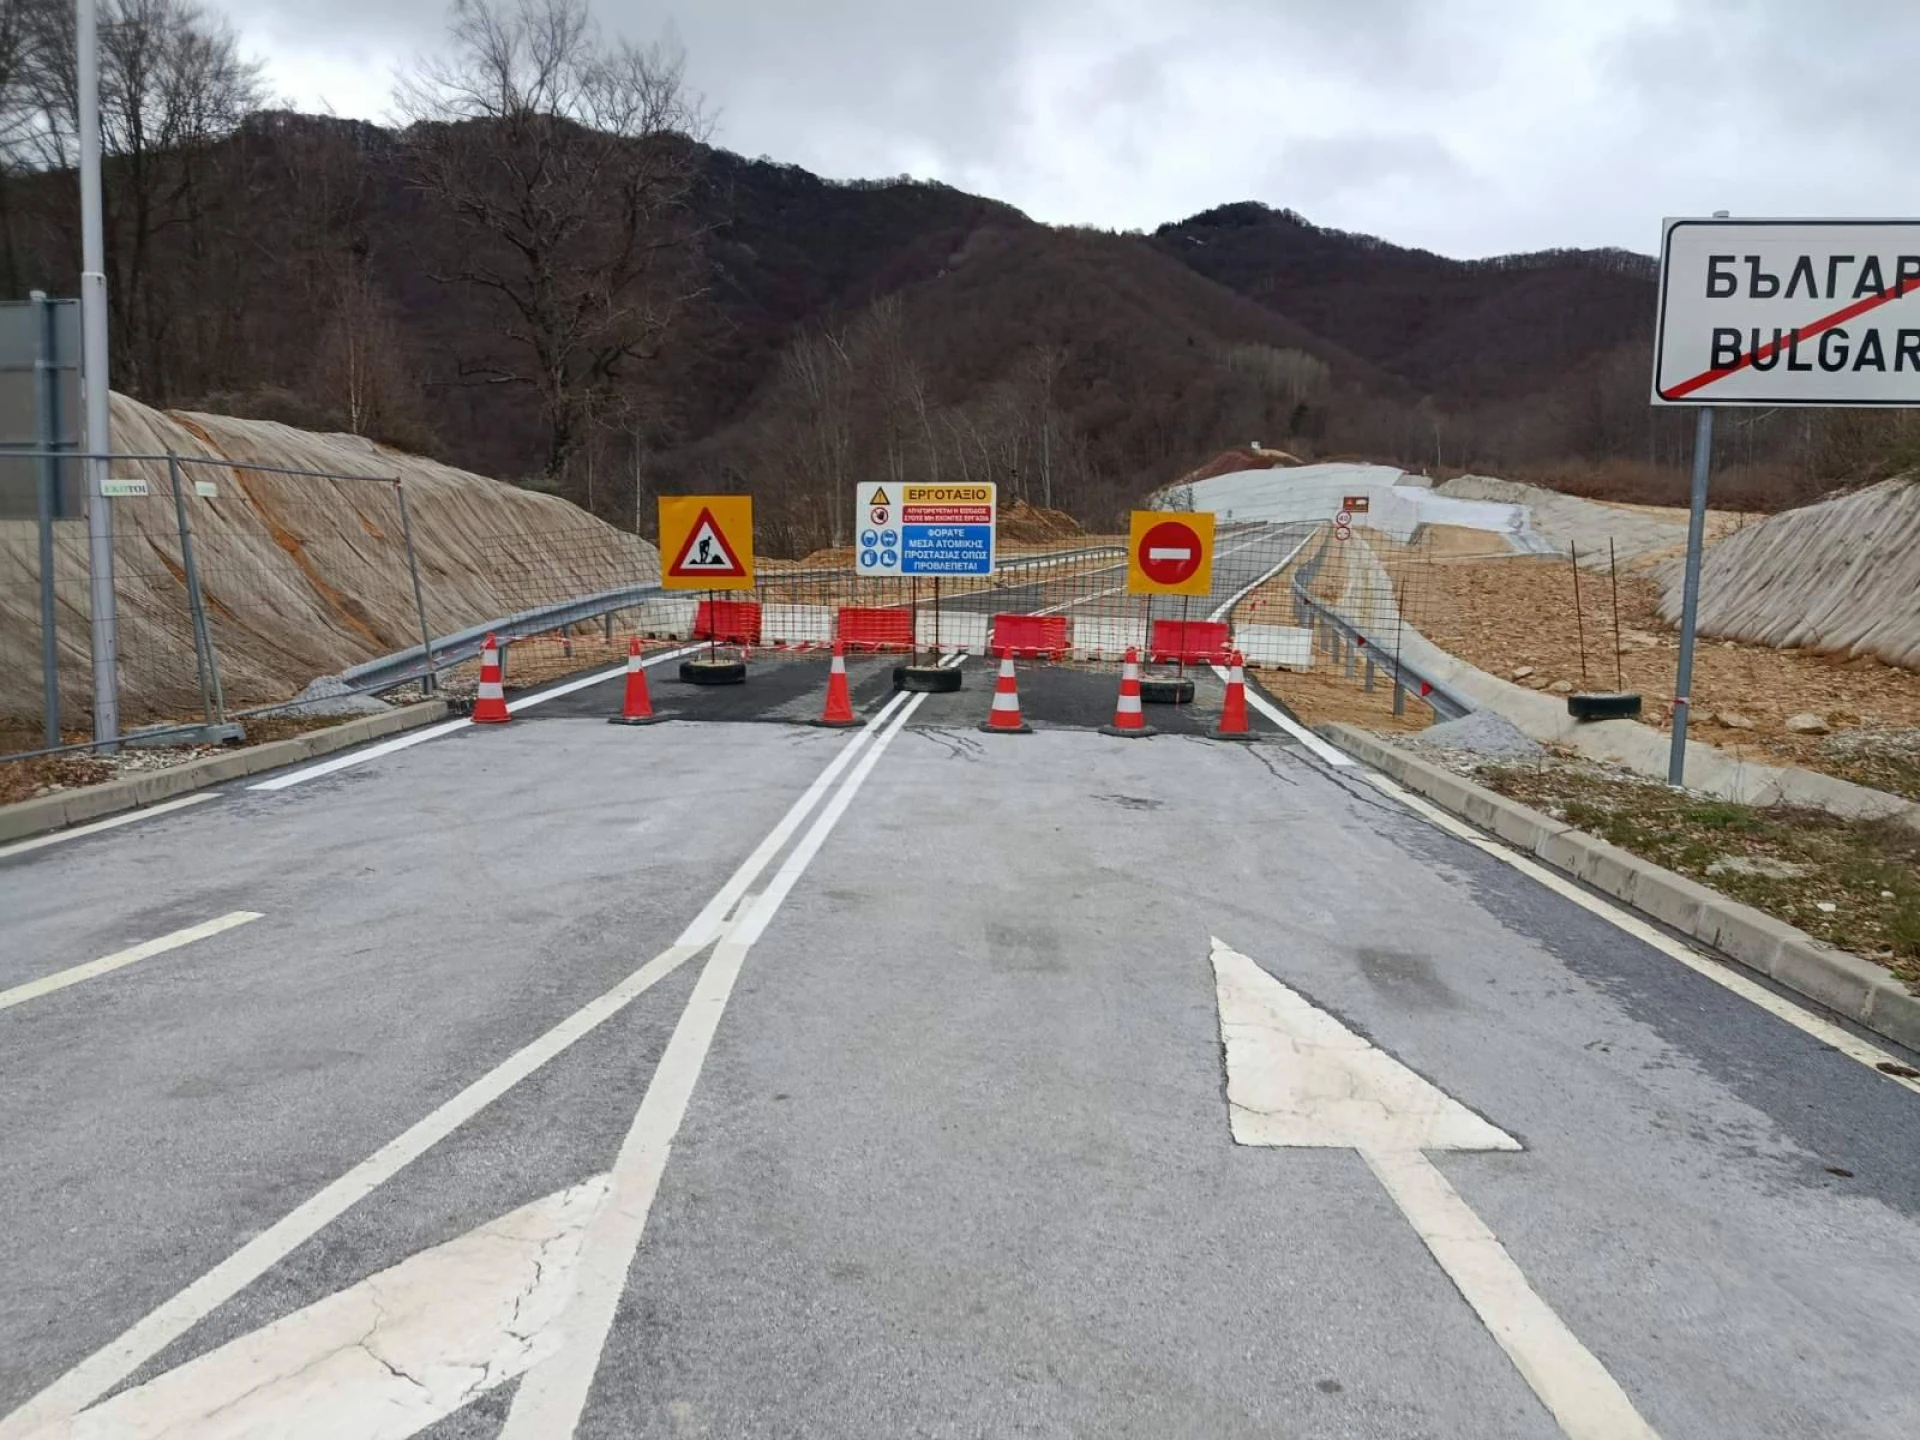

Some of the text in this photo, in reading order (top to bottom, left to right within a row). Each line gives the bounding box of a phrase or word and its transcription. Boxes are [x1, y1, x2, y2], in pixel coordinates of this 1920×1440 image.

[908, 489, 987, 500] ΕΡΓΟΤΑΞΙΟ
[928, 529, 965, 537] ΦΟΡΑΤΕ
[909, 540, 984, 548] ΜΕΣΑ ΑΤΟΜΙΚΗΣ
[904, 551, 988, 559] ΠΡΟΣΤΑΣΙΑΣ ΟΠΩΣ
[914, 562, 977, 570] ΠΡΟΒΛΕΠΕΤΑΙ
